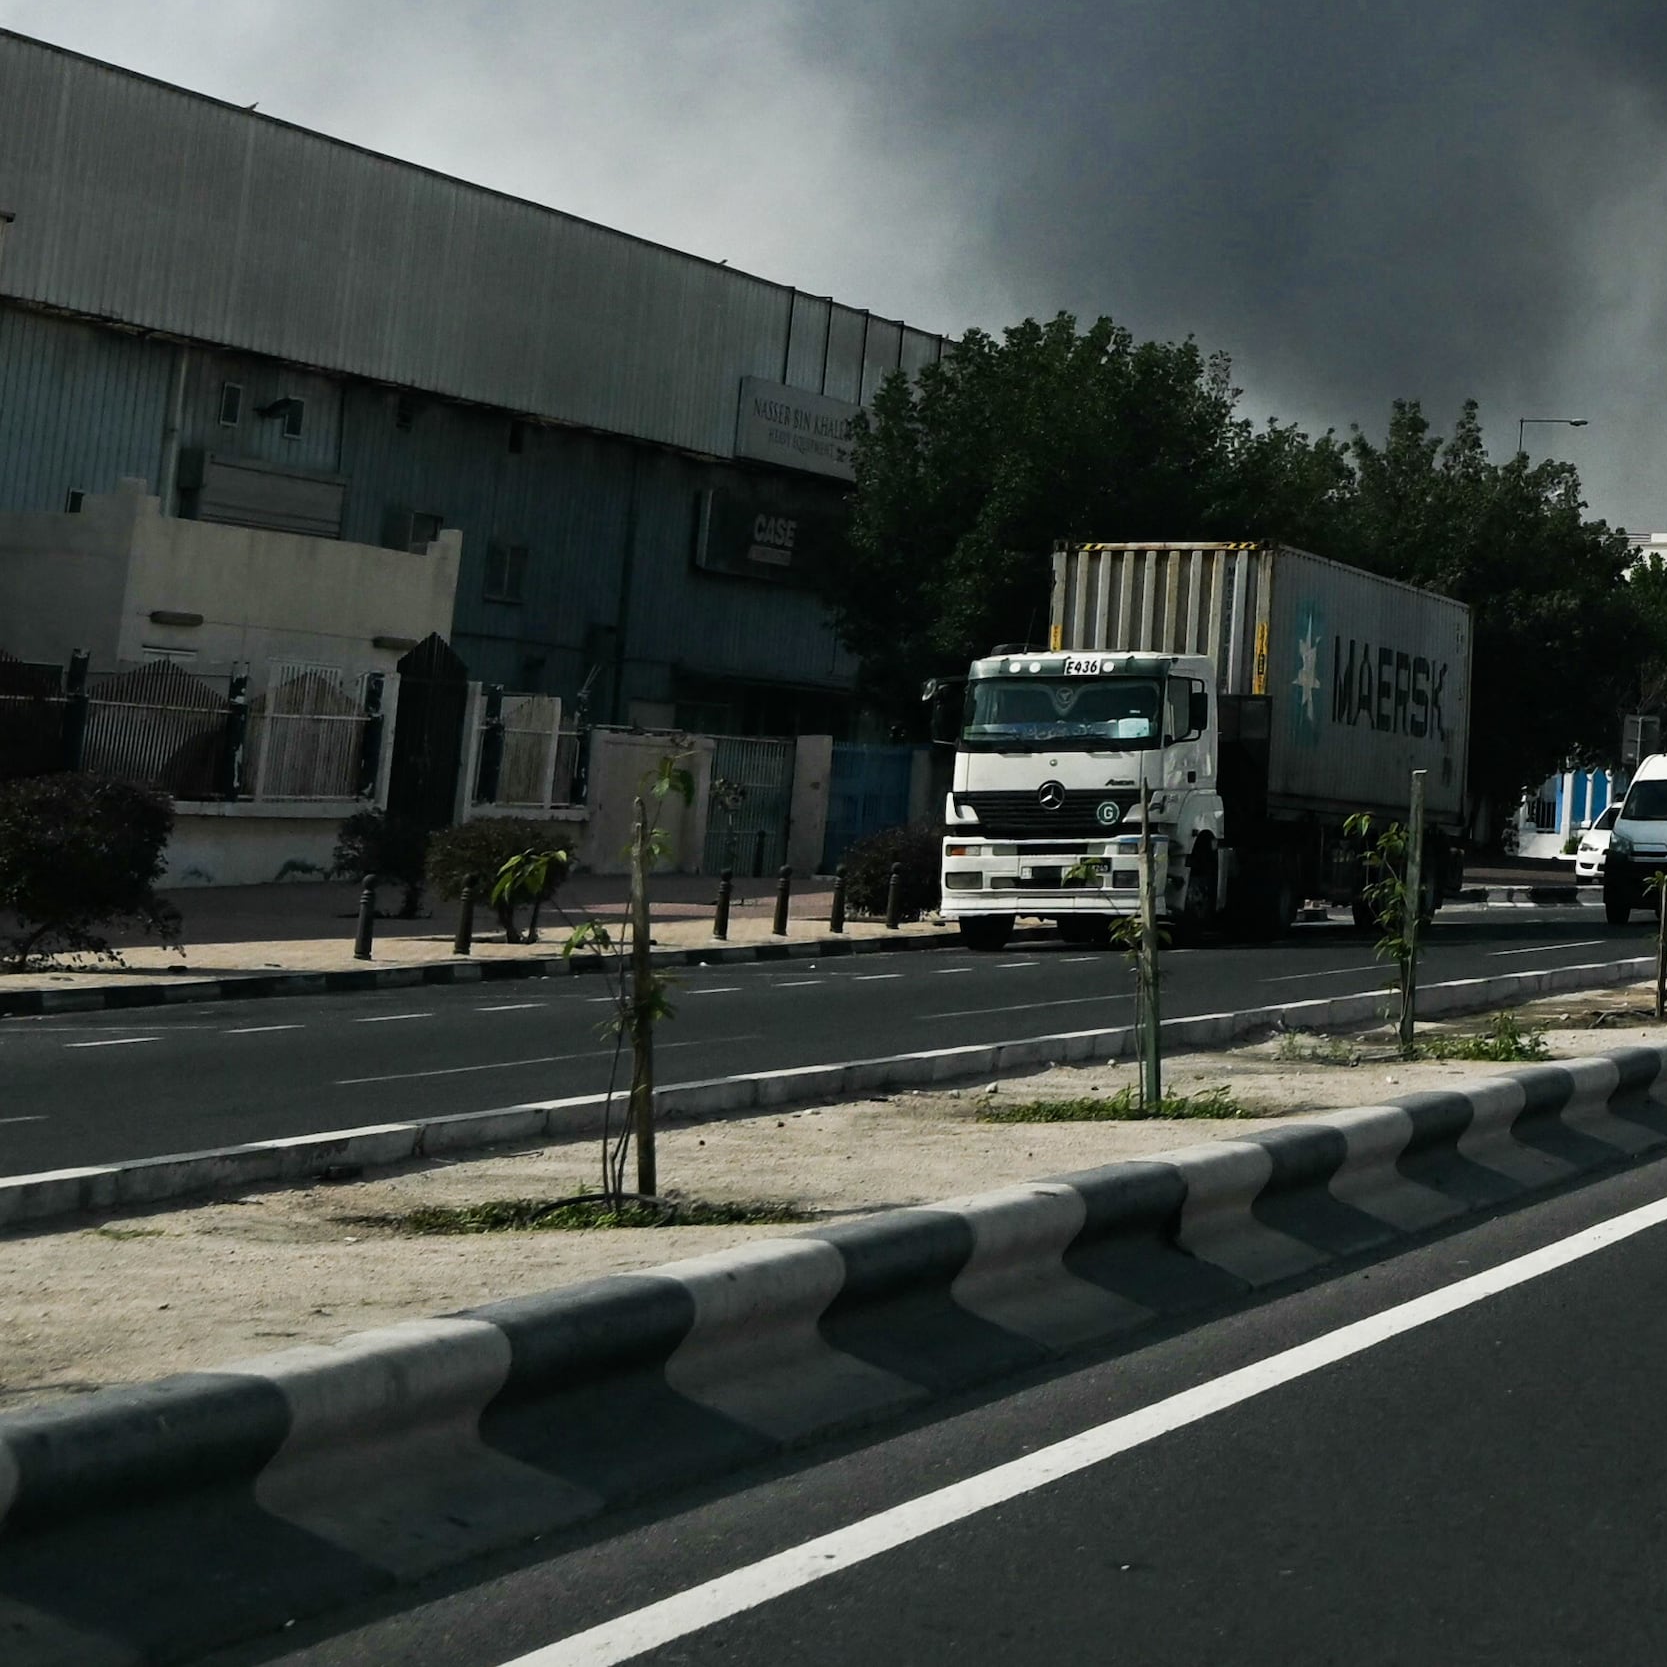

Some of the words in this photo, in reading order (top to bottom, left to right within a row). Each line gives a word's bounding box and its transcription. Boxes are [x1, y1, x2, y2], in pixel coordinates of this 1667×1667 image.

[753, 398, 791, 426] NASSER
[793, 408, 812, 431] BIN
[754, 513, 798, 547] CASE
[1066, 660, 1098, 674] E436
[1332, 635, 1447, 742] MAERSK
[1103, 806, 1113, 819] G
